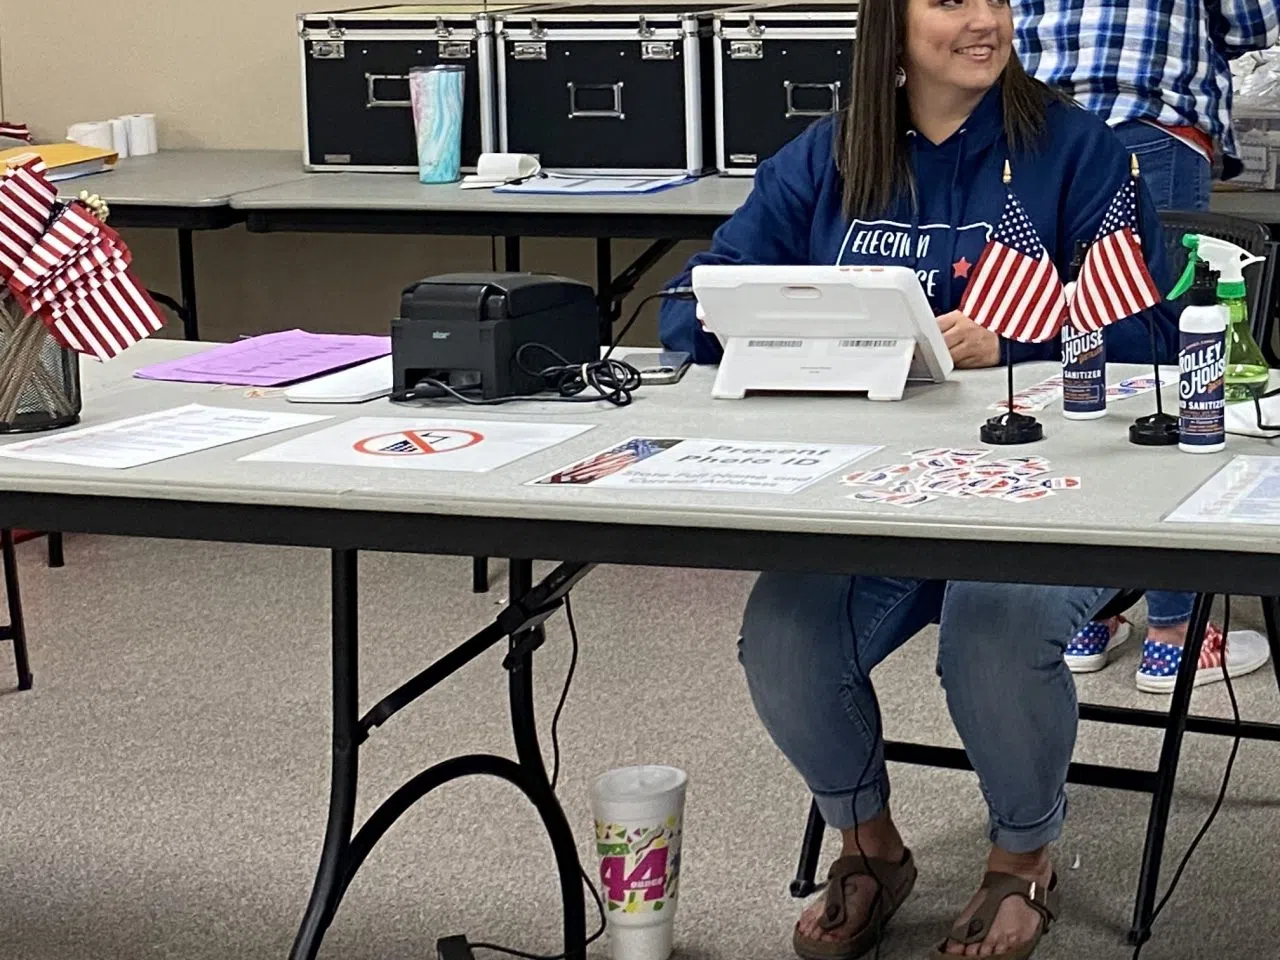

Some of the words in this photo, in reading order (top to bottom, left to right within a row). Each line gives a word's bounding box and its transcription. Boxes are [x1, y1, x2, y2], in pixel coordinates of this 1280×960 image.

[1061, 327, 1104, 367] HOUSE
[1064, 369, 1102, 380] SANITIZER
[1180, 353, 1227, 399] HOUS
[676, 454, 771, 465] Photo
[781, 458, 821, 466] ID
[708, 444, 832, 455] Present
[600, 846, 669, 902] 44
